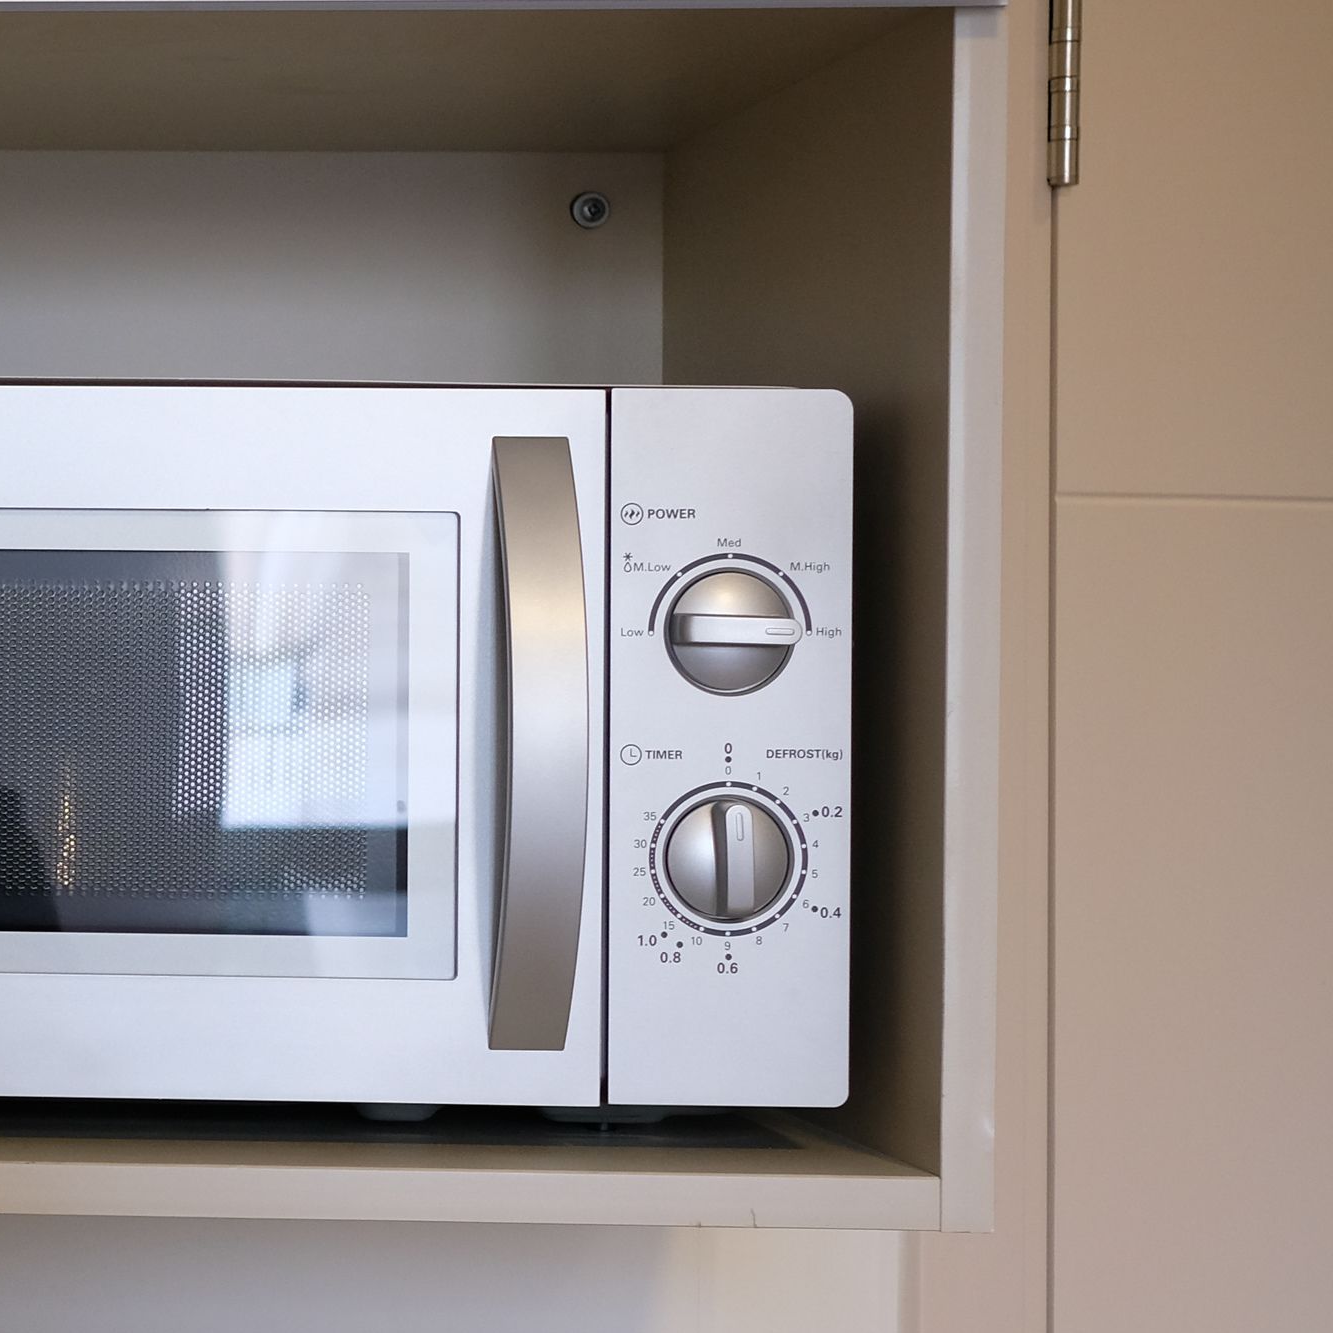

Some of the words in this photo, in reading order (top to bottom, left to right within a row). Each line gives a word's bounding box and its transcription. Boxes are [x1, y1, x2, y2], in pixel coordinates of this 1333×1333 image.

[647, 509, 696, 519] POWER
[717, 538, 742, 547] Med
[633, 562, 671, 572] M.Low
[790, 562, 830, 573] M.High
[621, 628, 644, 637] Low
[816, 628, 842, 638] High
[724, 743, 732, 754] 0
[645, 750, 682, 760] TIMER
[766, 749, 843, 760] DEFROST(kg)
[725, 766, 731, 775] 0
[757, 772, 761, 780] 1
[783, 787, 789, 795] 2
[644, 812, 657, 821] 35
[821, 807, 842, 817] 0.2
[803, 814, 810, 822] 3
[634, 839, 647, 848] 30
[812, 840, 819, 848] 4
[633, 868, 646, 876] 25
[812, 870, 818, 878] 5
[643, 897, 655, 906] 20
[803, 900, 809, 909] 6
[820, 907, 841, 918] 0.4
[664, 921, 675, 930] 15
[783, 924, 789, 932] 7
[638, 935, 657, 946] 1.0
[692, 937, 702, 945] 10
[756, 937, 762, 945] 8
[725, 942, 731, 950] 9
[660, 952, 681, 963] 0.8
[717, 963, 738, 974] 0.6
